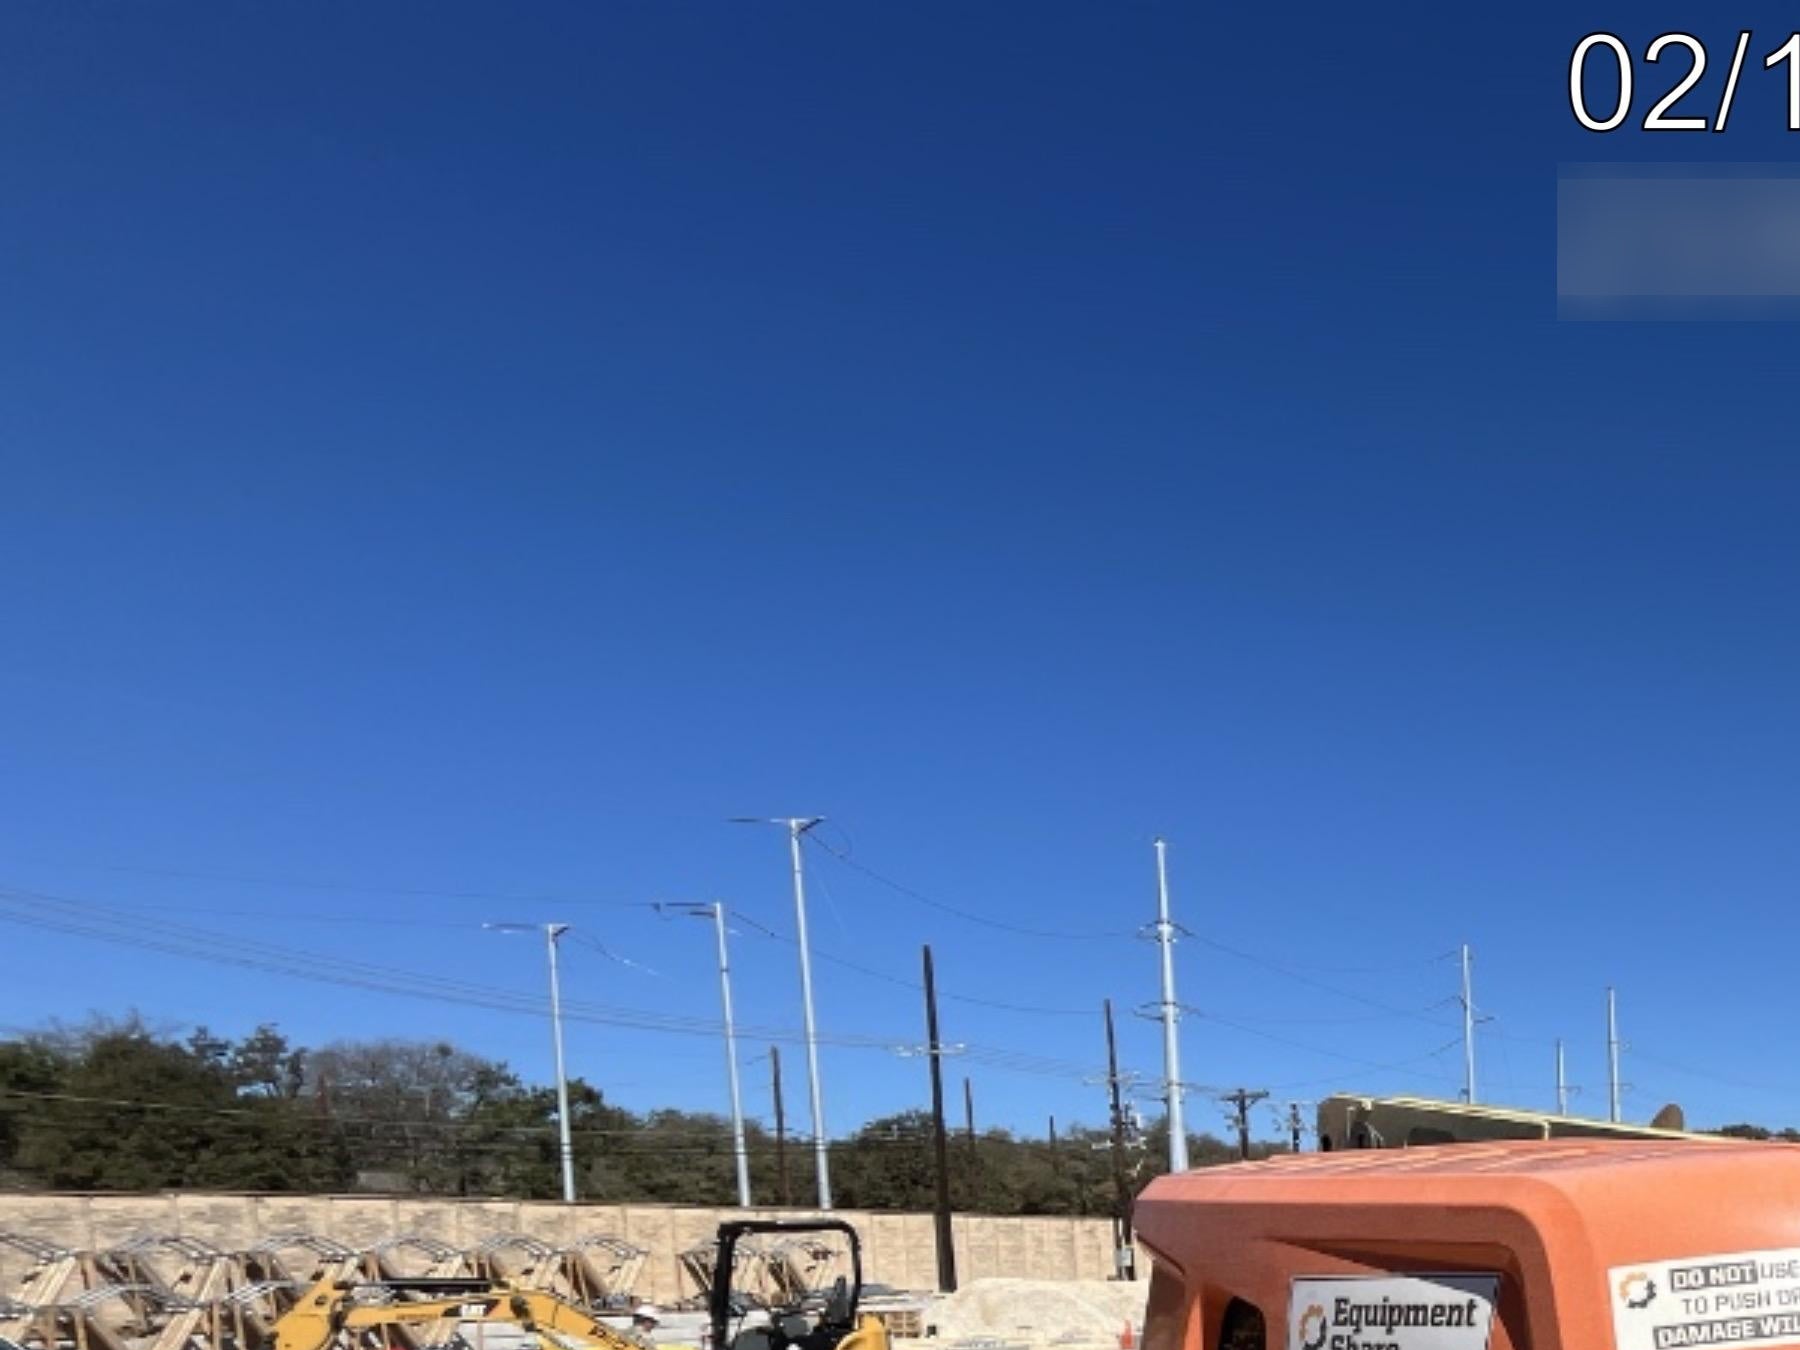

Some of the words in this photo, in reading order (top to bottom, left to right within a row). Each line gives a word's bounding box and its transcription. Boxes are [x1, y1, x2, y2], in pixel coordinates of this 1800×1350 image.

[1671, 1267, 1705, 1289] DO
[1709, 1263, 1754, 1285] NOT
[1759, 1260, 1800, 1280] USE
[1331, 1296, 1478, 1336] Equipment
[1682, 1297, 1708, 1316] TO
[1714, 1291, 1772, 1313] PUSH
[1657, 1319, 1755, 1348] DAMAGE
